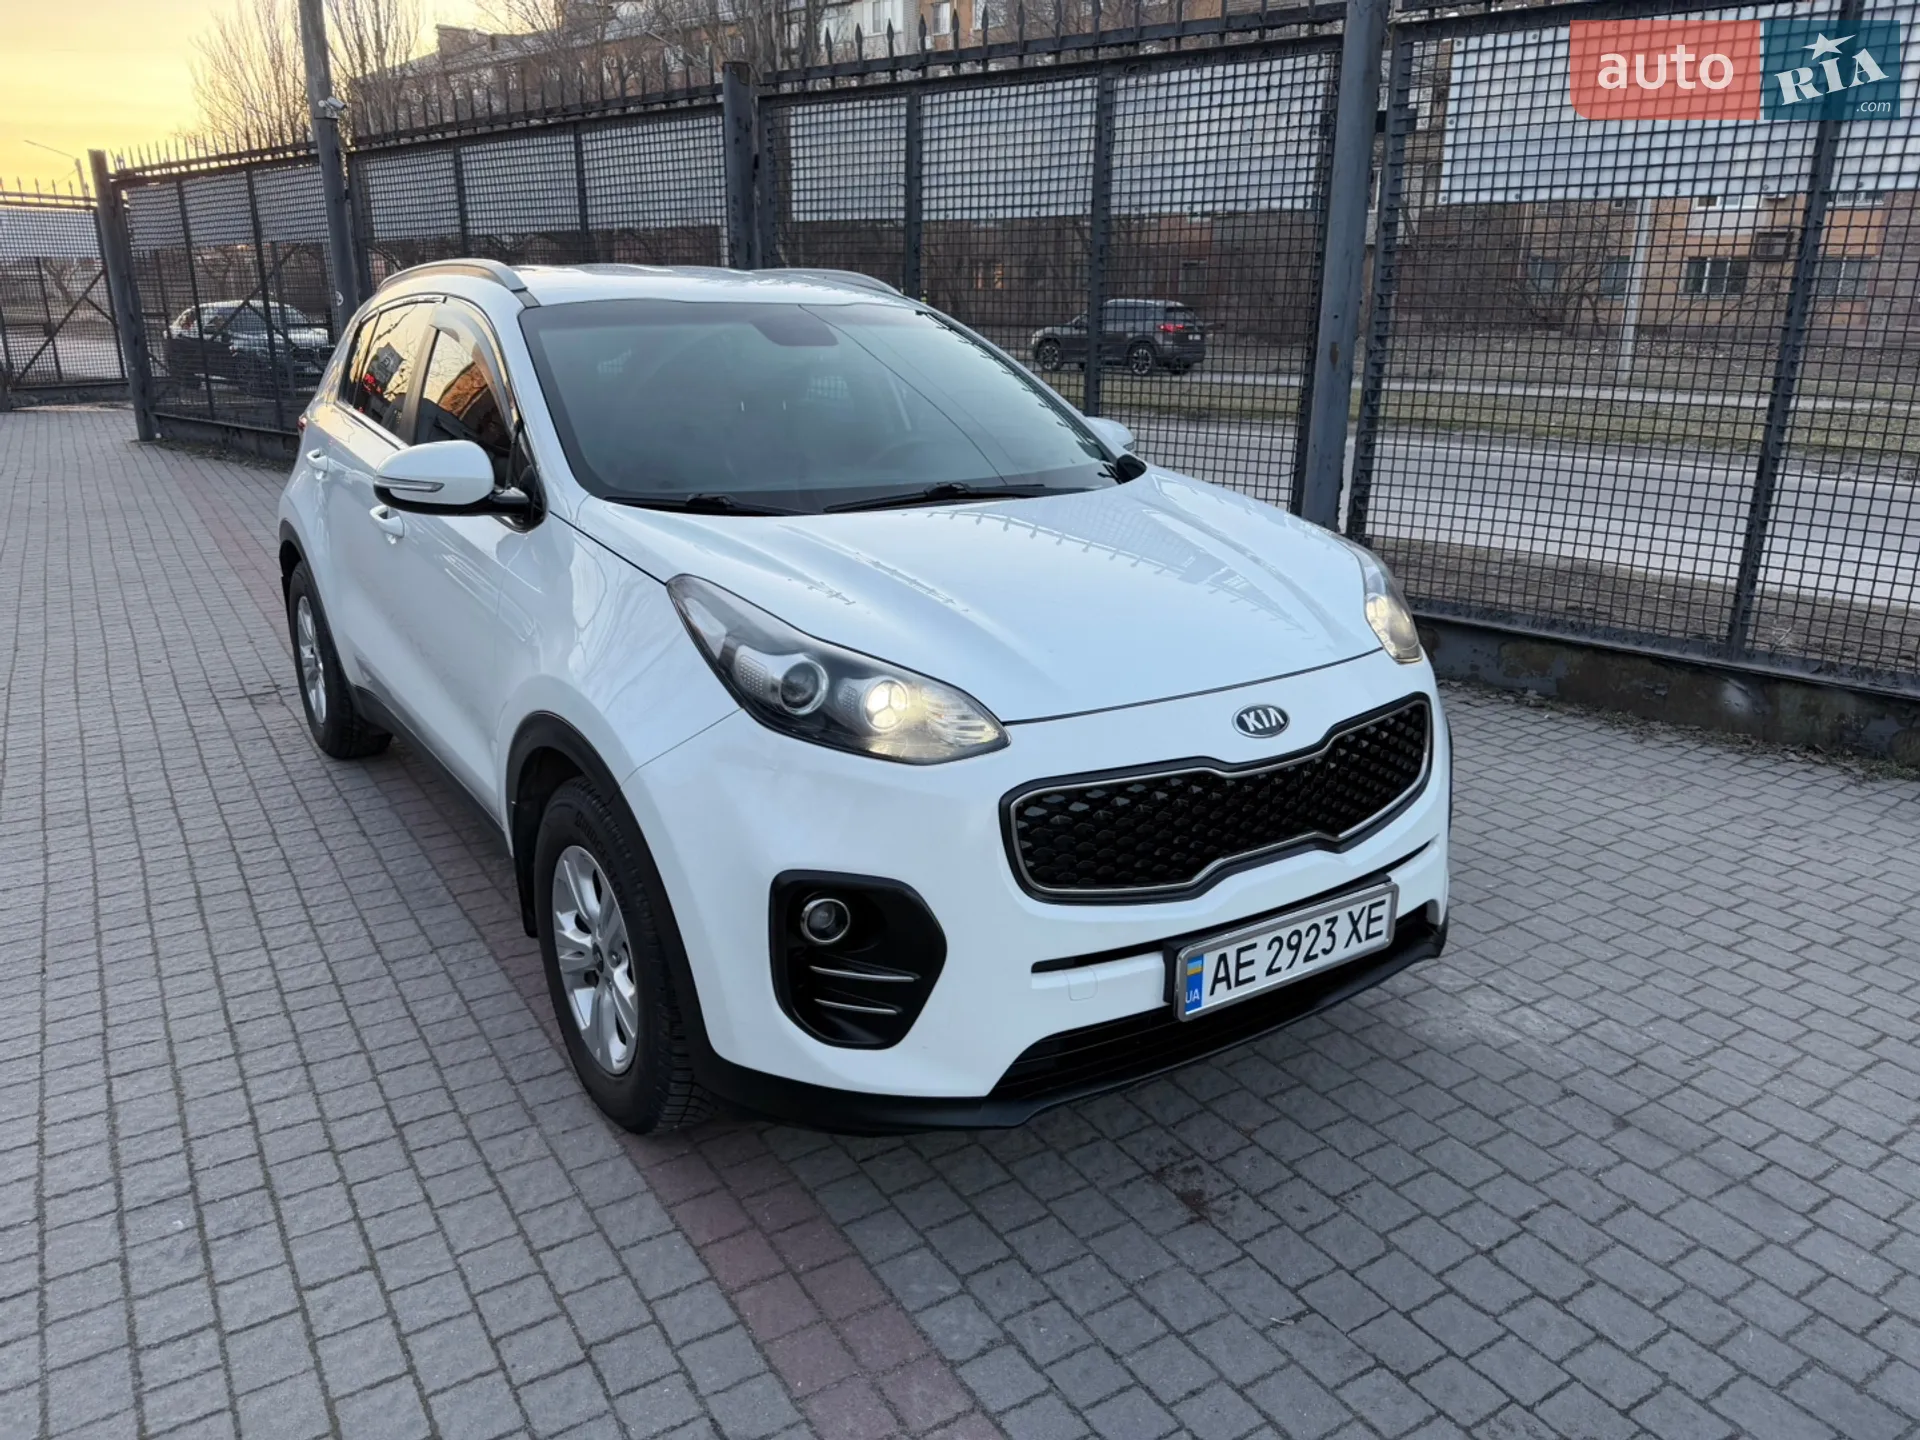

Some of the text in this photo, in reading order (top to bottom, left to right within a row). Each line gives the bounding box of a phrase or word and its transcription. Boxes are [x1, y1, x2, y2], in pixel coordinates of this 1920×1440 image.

[1240, 707, 1286, 732] KIA
[1209, 899, 1387, 996] AE 2923 XE
[1185, 988, 1201, 1003] UA
